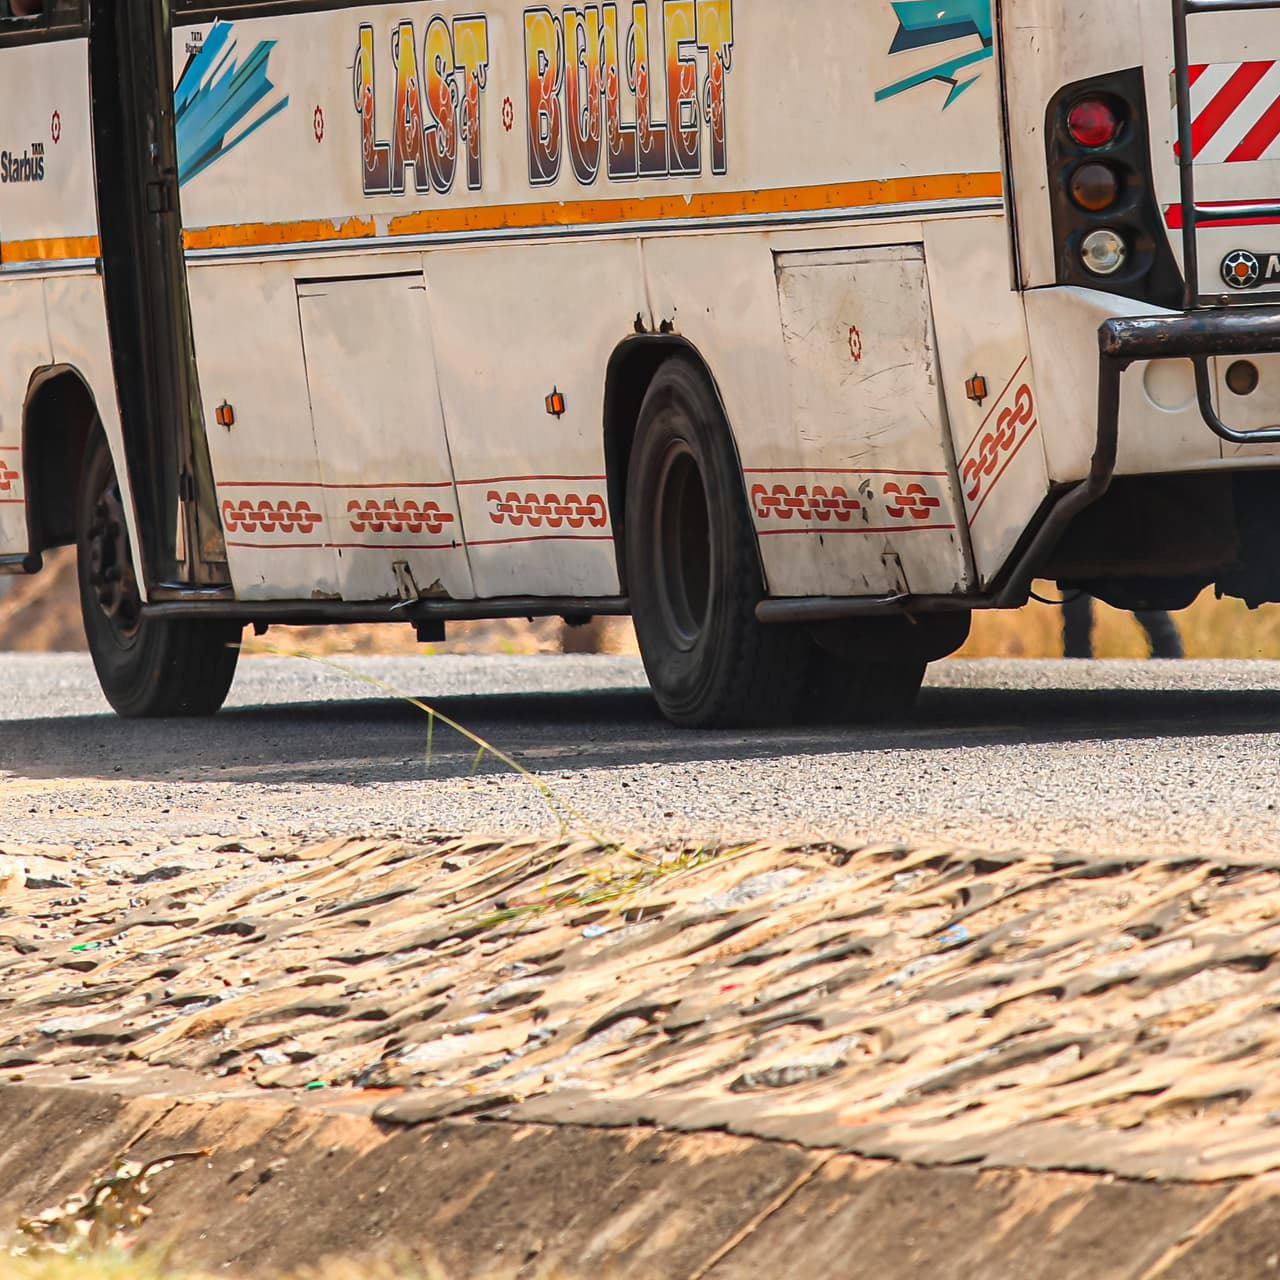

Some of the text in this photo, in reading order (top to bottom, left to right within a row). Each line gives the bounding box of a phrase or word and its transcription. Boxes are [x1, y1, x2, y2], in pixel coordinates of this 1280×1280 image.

[353, 14, 490, 198] LAST
[31, 142, 45, 156] TATA
[1, 150, 45, 183] Starbus
